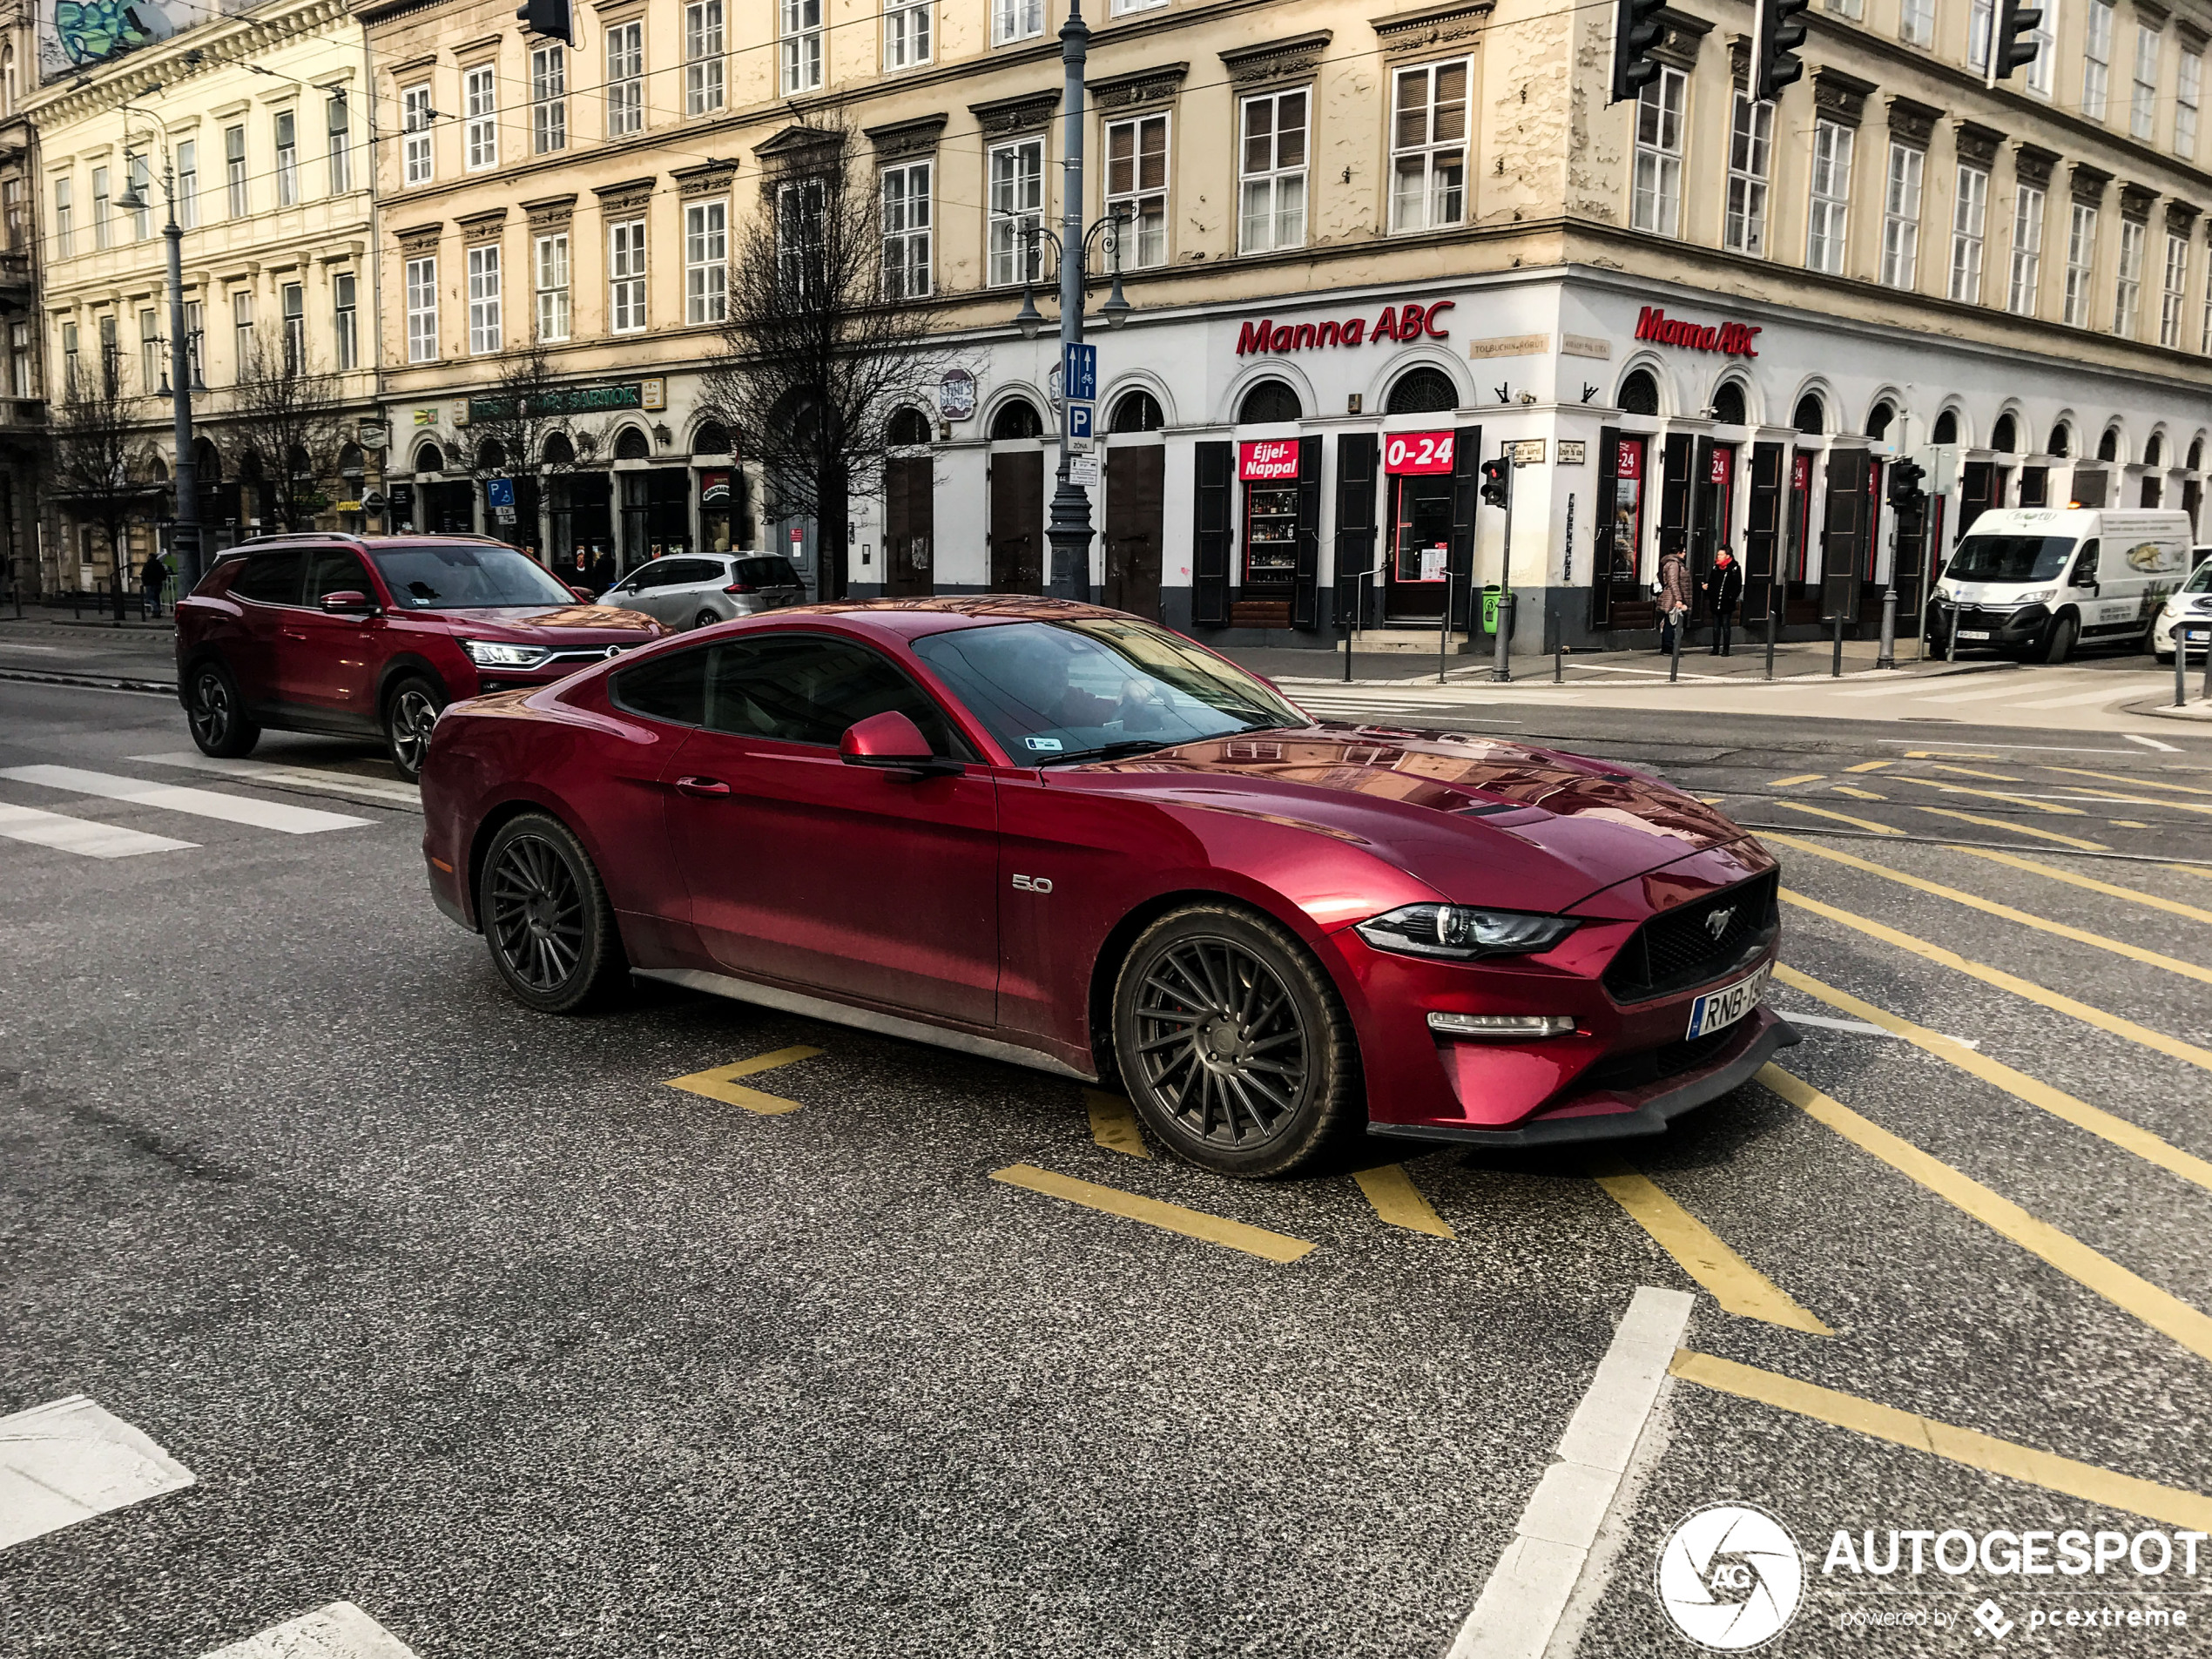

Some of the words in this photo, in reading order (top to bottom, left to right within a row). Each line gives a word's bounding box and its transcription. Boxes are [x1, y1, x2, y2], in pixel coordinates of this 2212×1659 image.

[1236, 319, 1366, 355] Manna
[1369, 300, 1456, 342] ABC
[1635, 306, 1716, 350] Manna
[1712, 321, 1763, 357] ABC
[1253, 442, 1289, 462] Éjjel-
[1387, 437, 1453, 467] 0-24
[1618, 453, 1635, 468] -24
[1245, 459, 1297, 478] Nappal
[1012, 873, 1053, 894] 5.0
